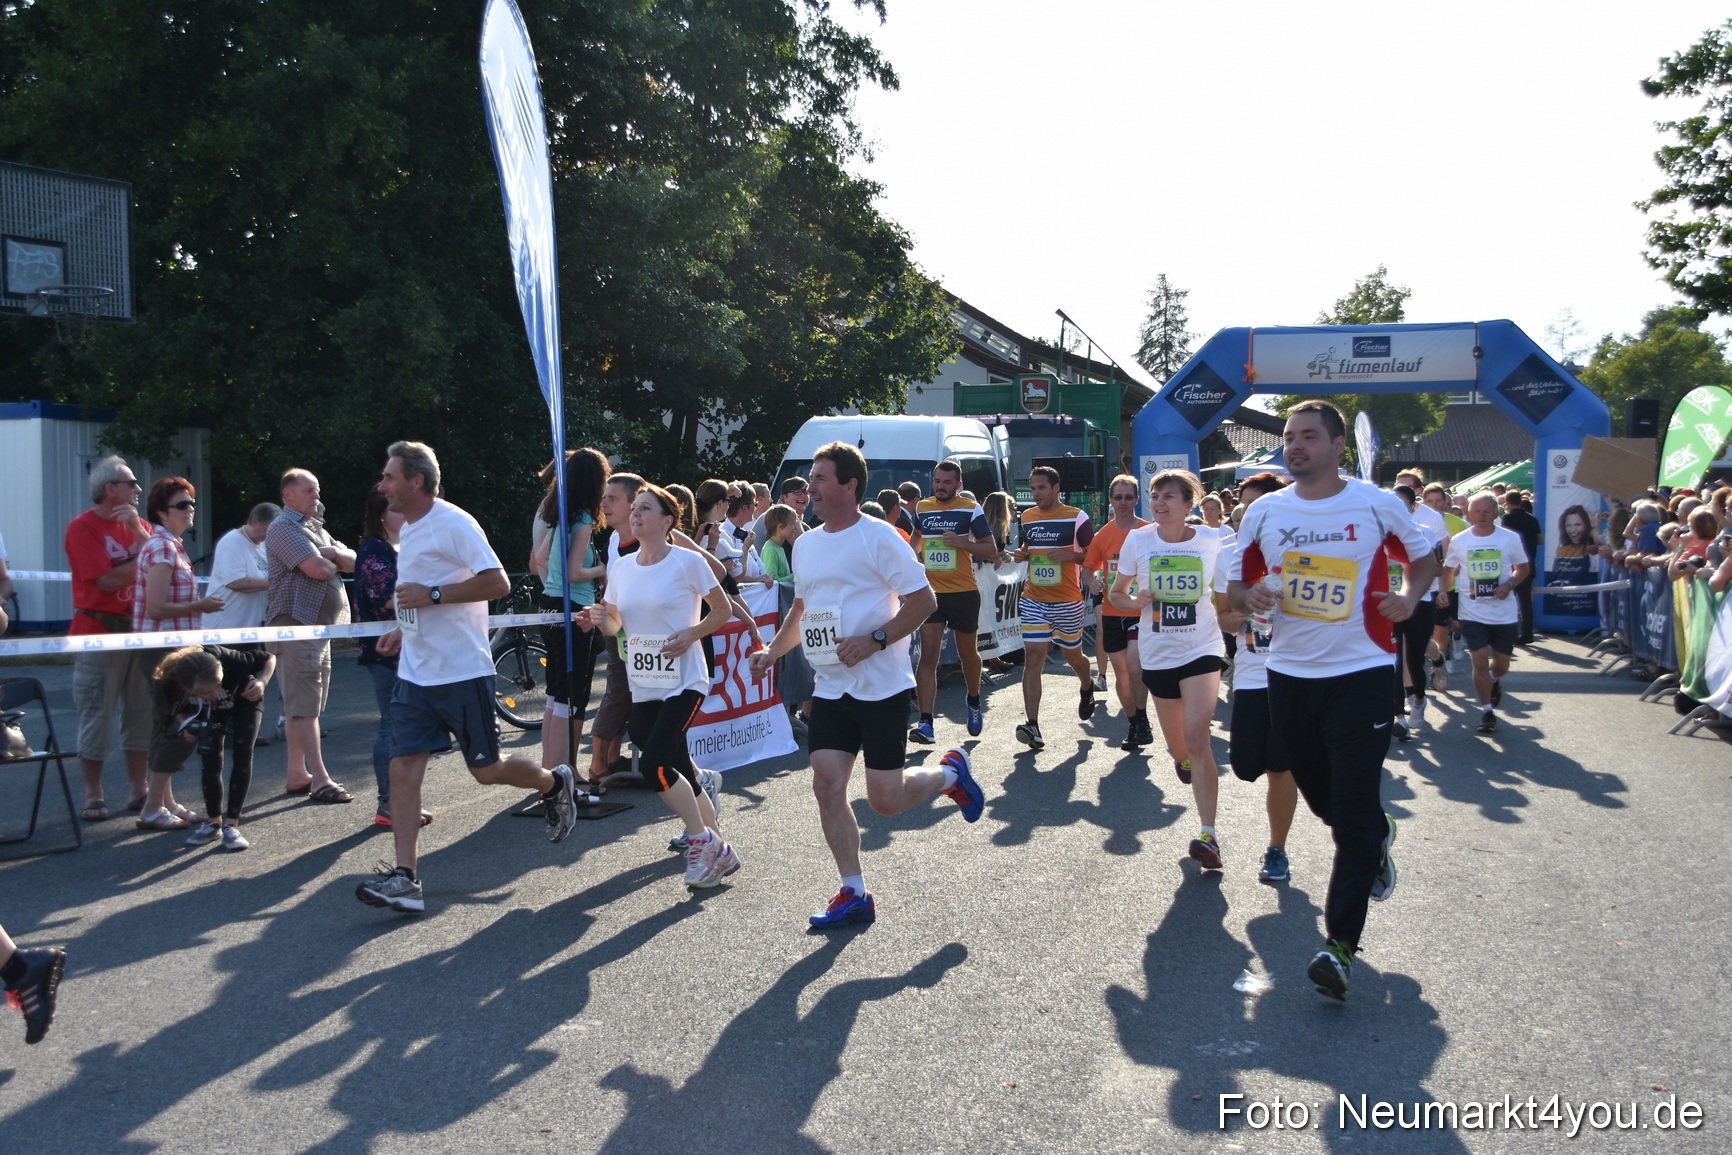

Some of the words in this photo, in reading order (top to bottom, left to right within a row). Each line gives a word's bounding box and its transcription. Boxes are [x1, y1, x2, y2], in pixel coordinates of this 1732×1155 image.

[1339, 357, 1423, 374] firmenlauf
[1183, 391, 1226, 400] Fischer
[1696, 424, 1724, 452] AOK
[1664, 444, 1697, 476] AOK
[929, 552, 950, 562] 408
[1034, 567, 1055, 578] 409
[1471, 562, 1498, 572] 1159
[1155, 575, 1198, 590] 1153
[1478, 584, 1493, 593] RW
[1288, 578, 1346, 606] 1515
[1166, 606, 1187, 619] RW
[630, 637, 671, 648] df-sports
[805, 626, 837, 648] 8911
[634, 652, 675, 671] 8912
